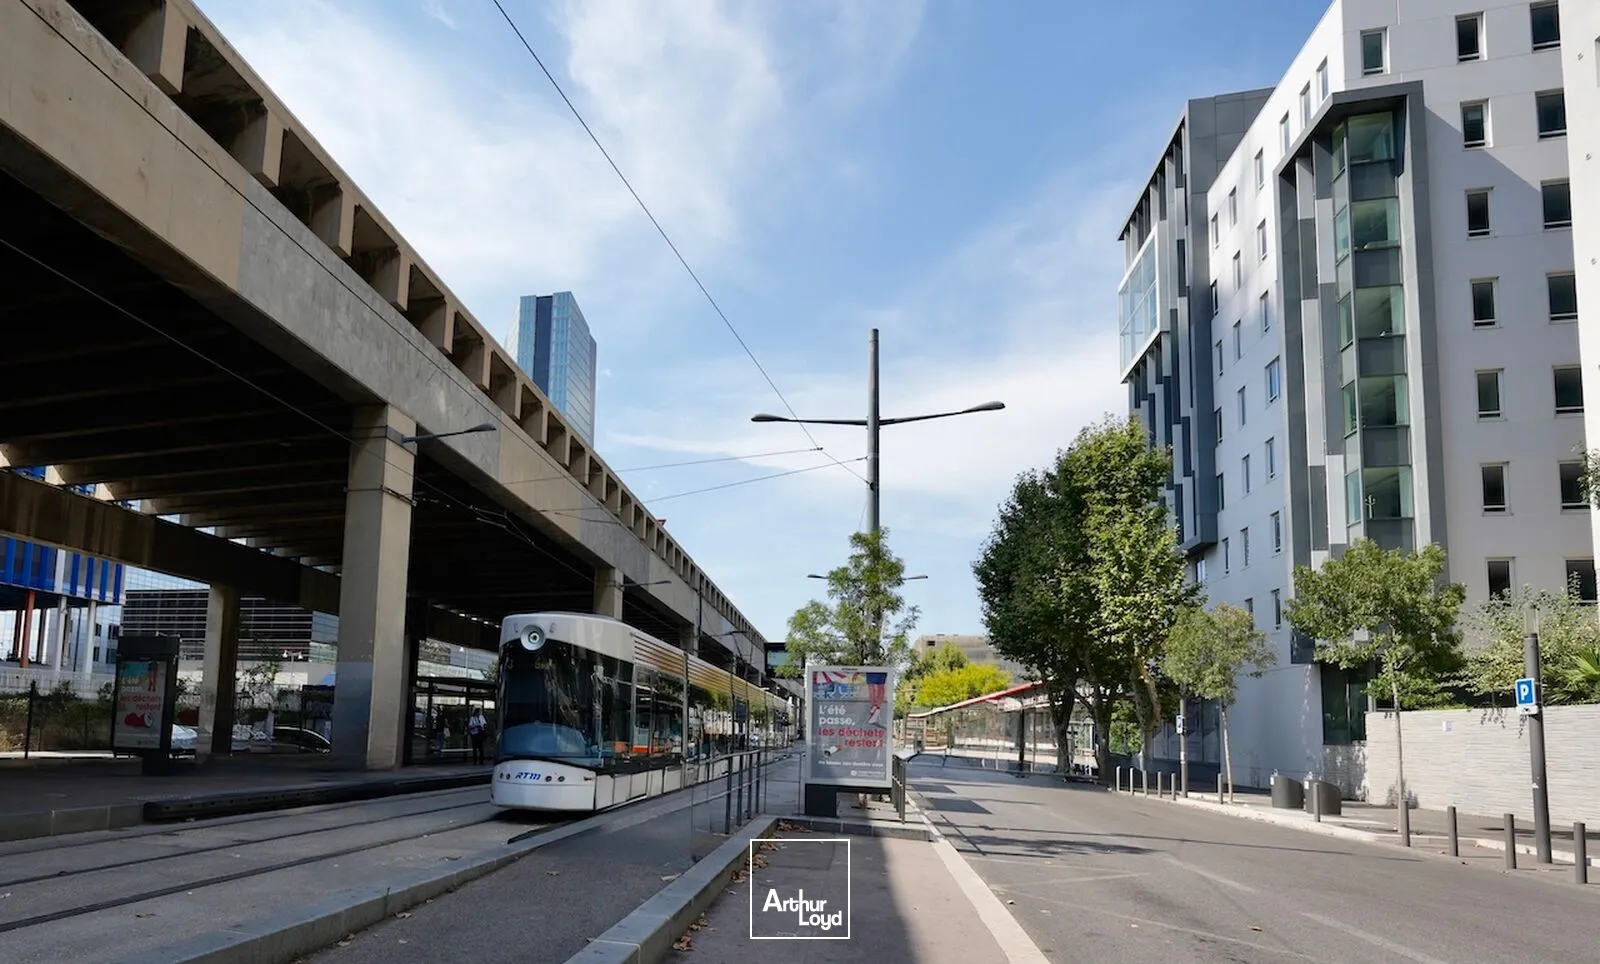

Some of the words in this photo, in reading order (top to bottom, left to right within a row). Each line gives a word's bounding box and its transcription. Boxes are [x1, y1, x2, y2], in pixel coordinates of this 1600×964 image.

[1520, 684, 1529, 700] P
[819, 705, 846, 715] L'été
[819, 717, 855, 727] passe,
[818, 728, 835, 736] les
[839, 728, 884, 737] déchets
[515, 772, 541, 780] RTM
